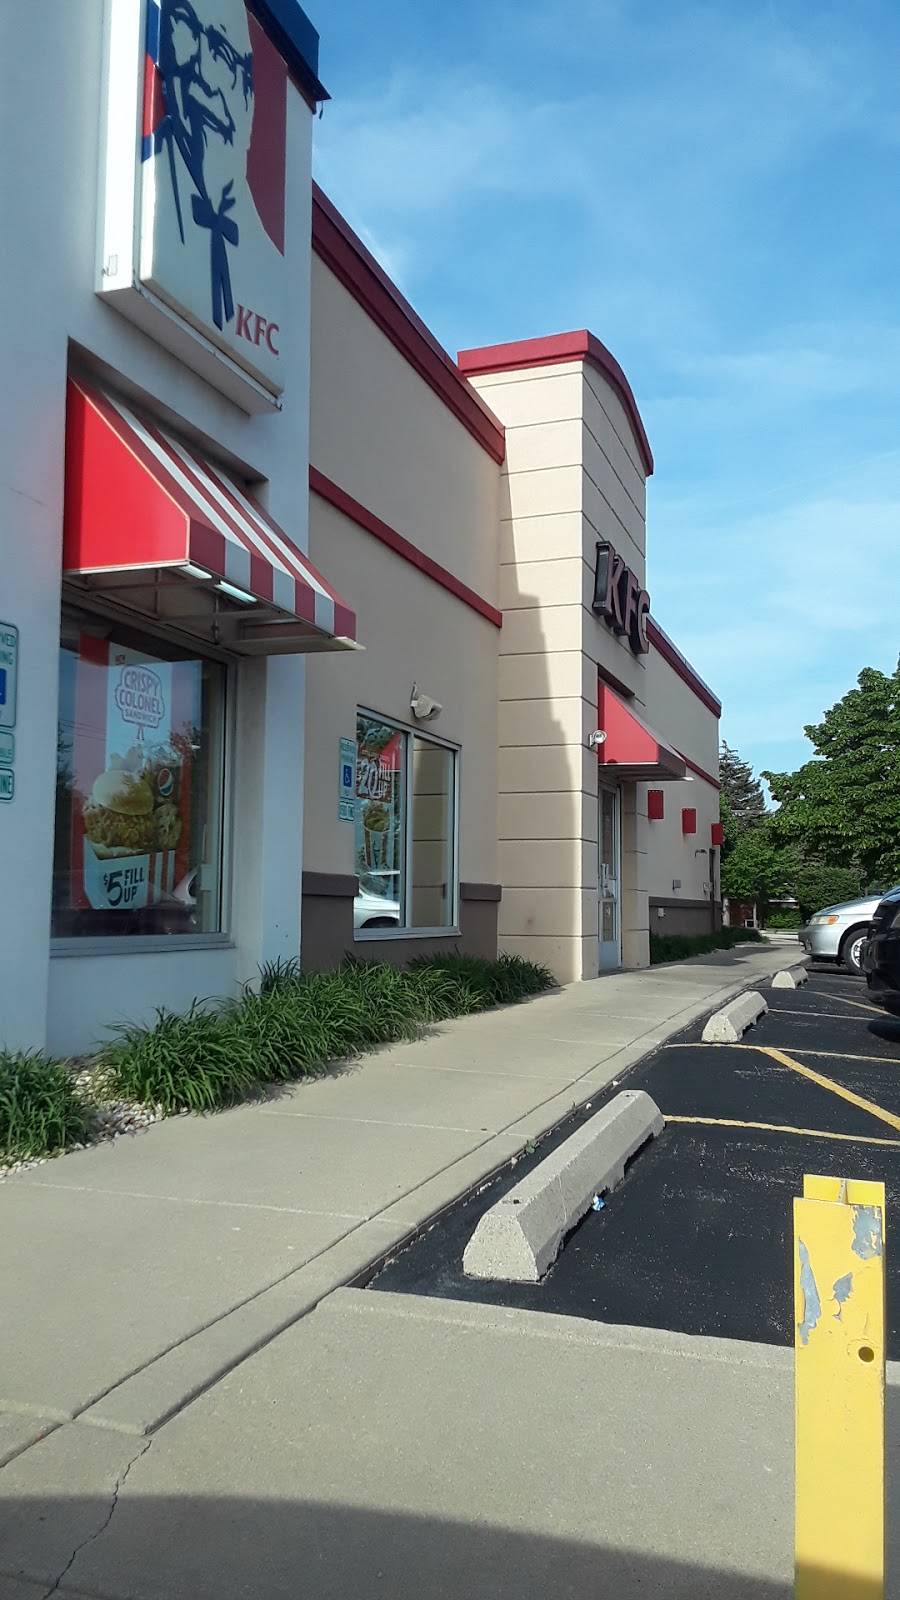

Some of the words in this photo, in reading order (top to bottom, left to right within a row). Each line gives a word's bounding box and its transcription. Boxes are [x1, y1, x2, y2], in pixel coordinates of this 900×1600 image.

[236, 303, 280, 356] KFC
[593, 541, 650, 655] KFC
[124, 669, 160, 696] CRISPY
[119, 688, 161, 715] COLONEL
[103, 870, 123, 907] $5
[124, 866, 145, 886] FILL
[124, 885, 138, 903] UP
